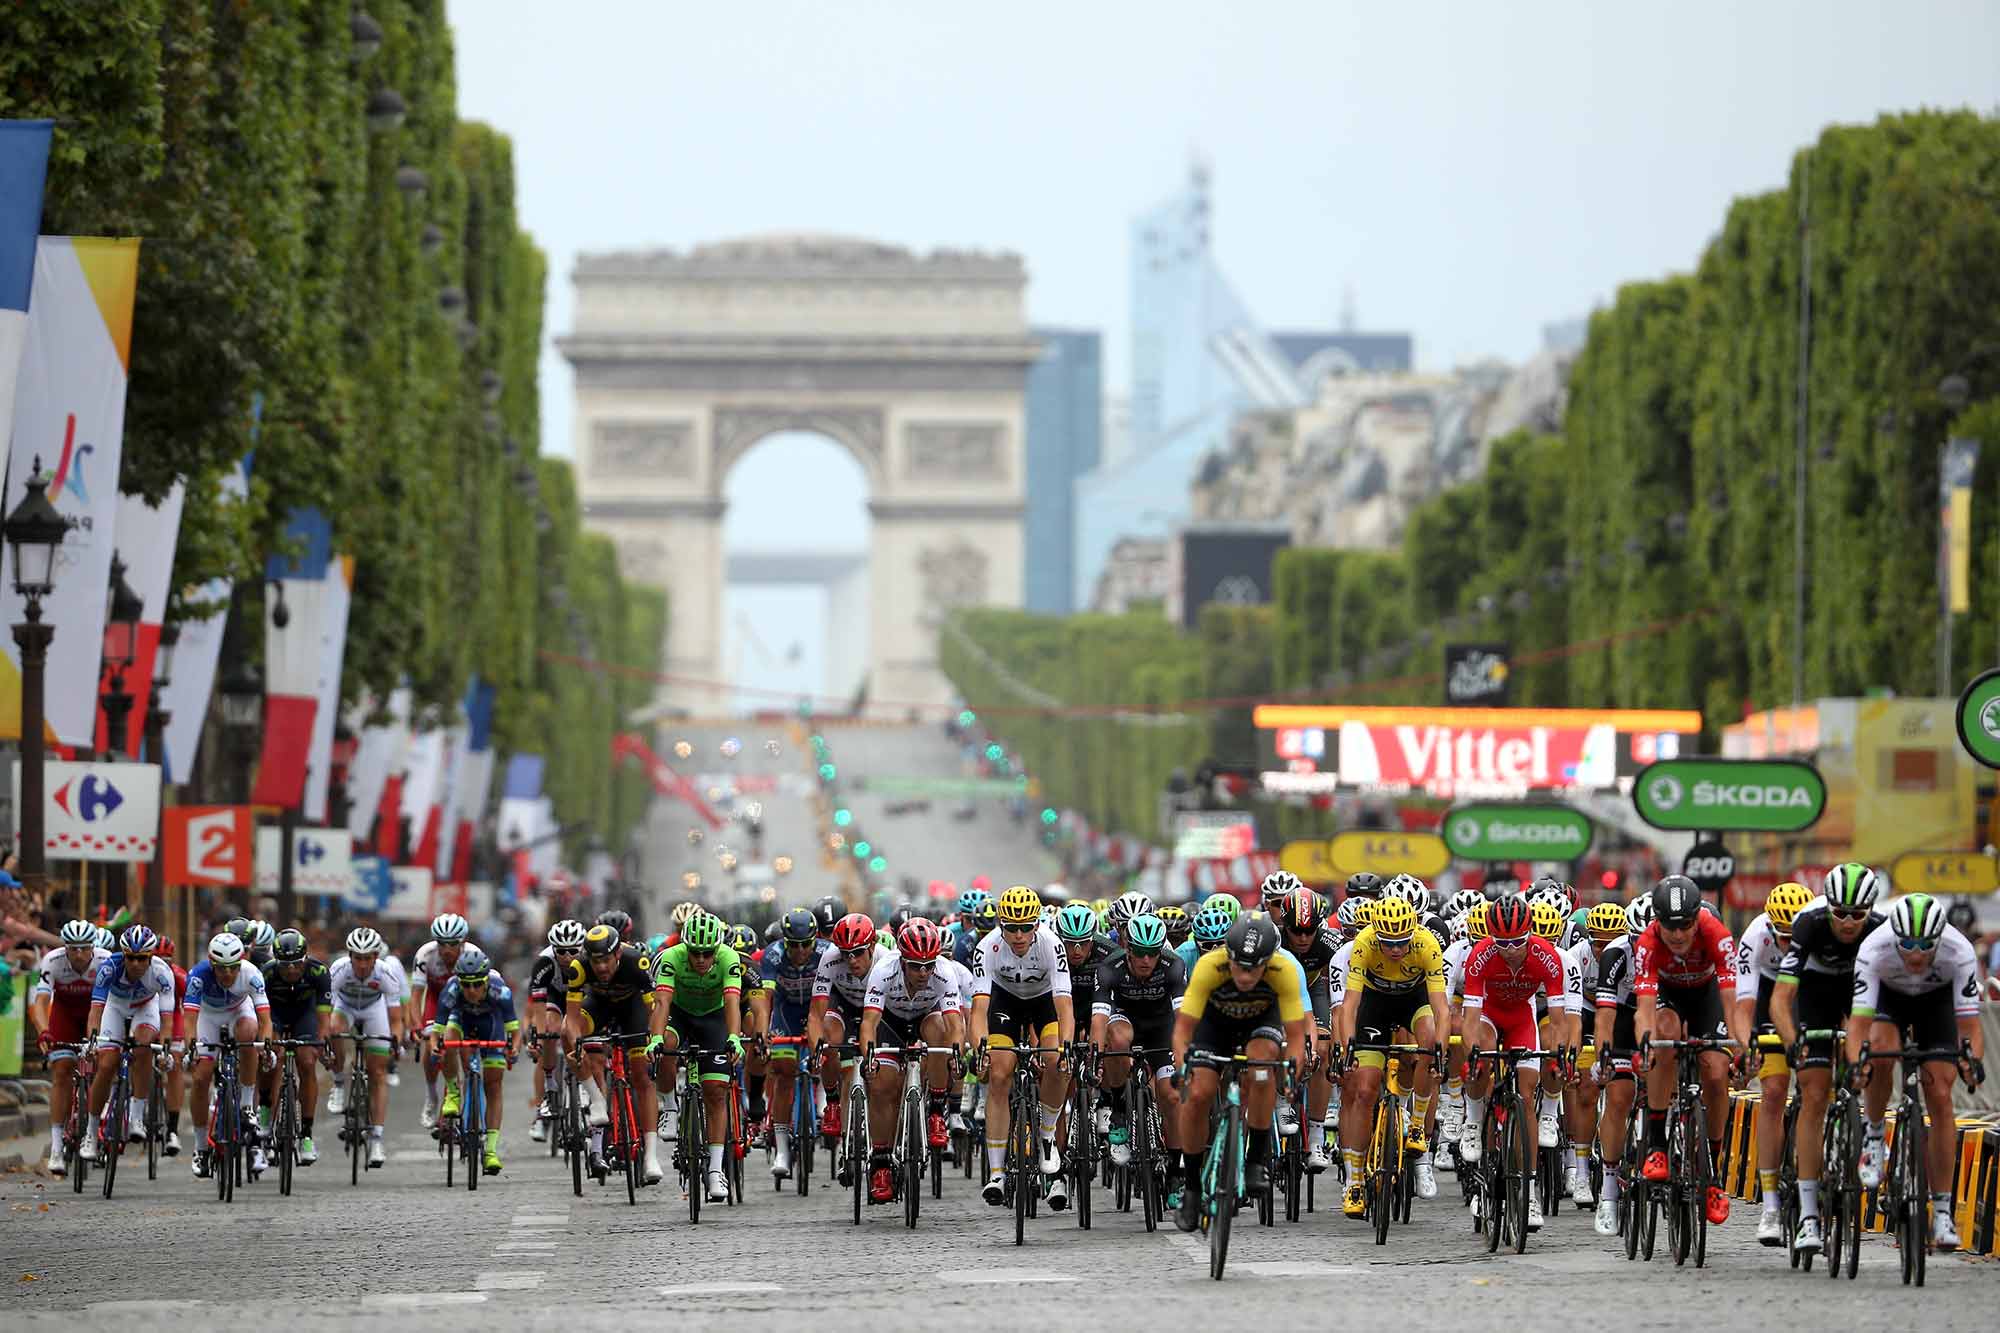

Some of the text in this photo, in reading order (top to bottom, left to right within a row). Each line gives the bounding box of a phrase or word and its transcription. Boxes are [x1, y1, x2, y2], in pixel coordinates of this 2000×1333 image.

[1394, 724, 1549, 781] Vittel
[1692, 780, 1813, 807] ŠKODA
[1487, 818, 1581, 843] ŠKODA
[1685, 856, 1734, 878] 200
[1468, 944, 1498, 977] Cofidis
[1531, 944, 1560, 979] Cofidis
